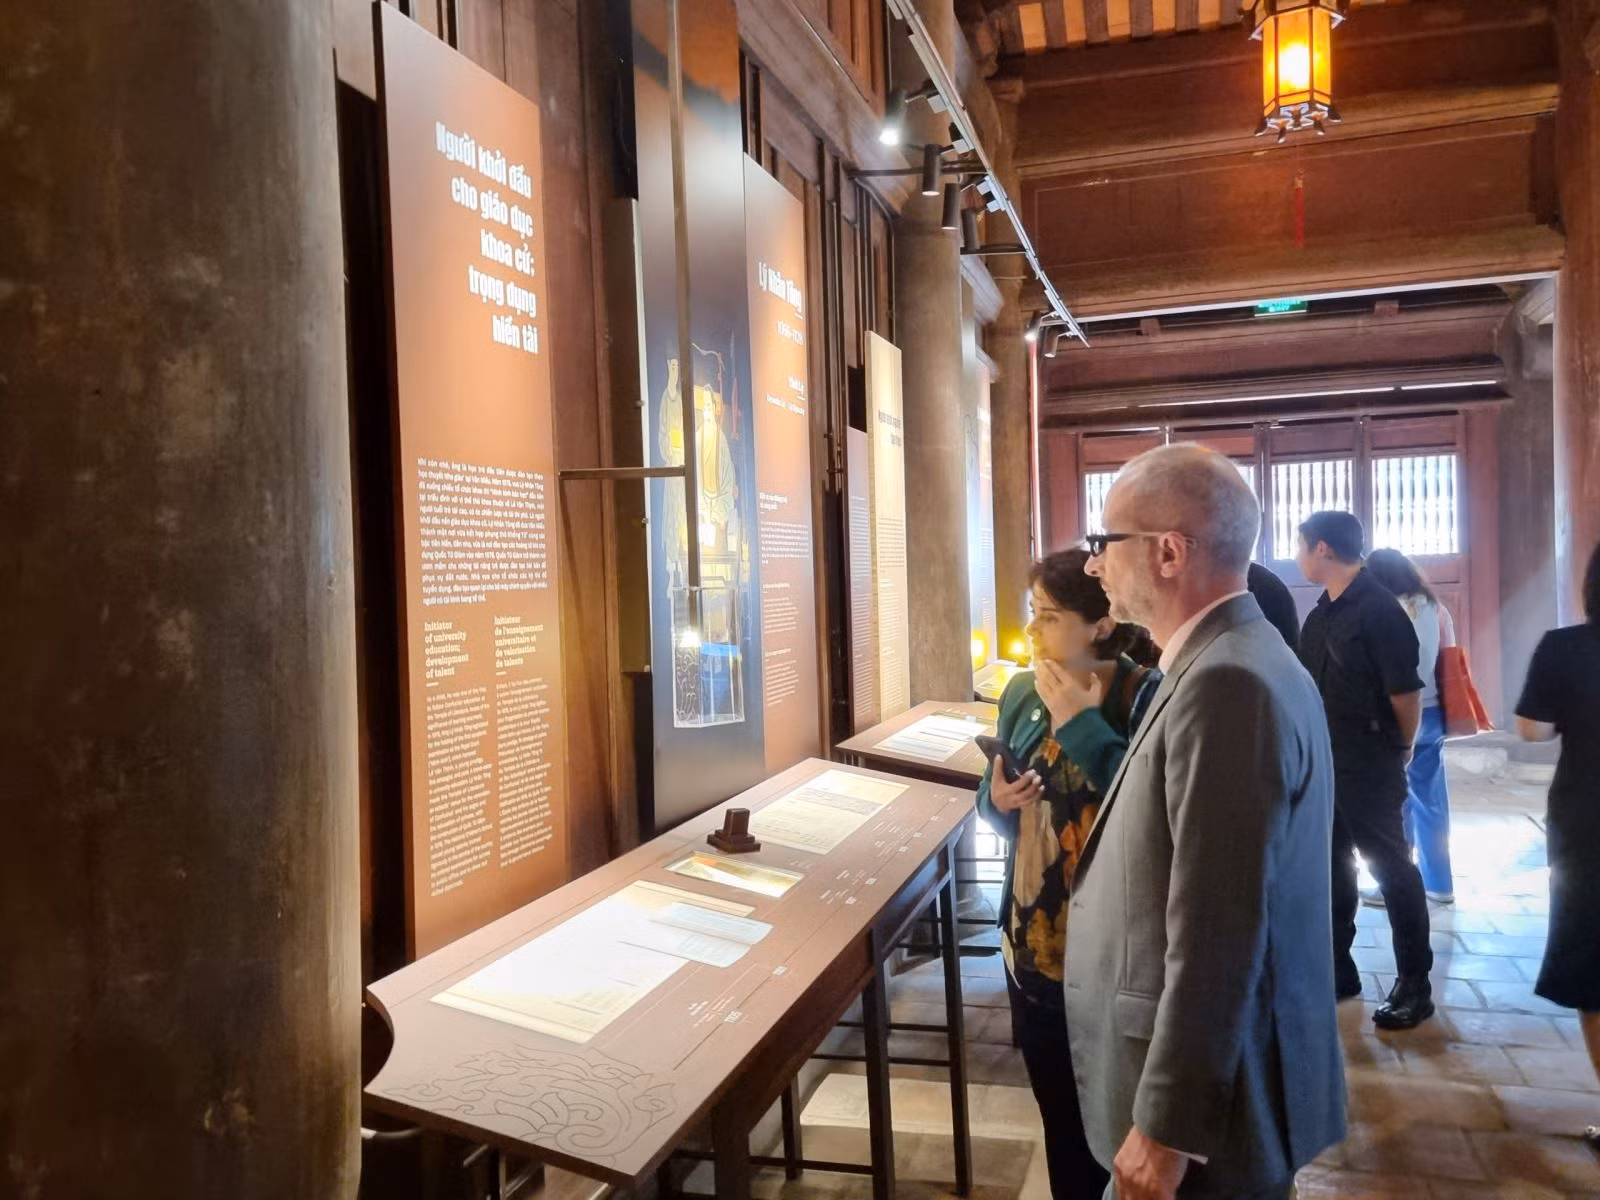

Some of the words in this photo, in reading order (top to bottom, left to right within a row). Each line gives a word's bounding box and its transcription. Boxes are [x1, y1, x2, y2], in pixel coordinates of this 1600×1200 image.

[436, 121, 476, 169] Người
[478, 145, 506, 185] khởi
[509, 164, 532, 199] đầu
[451, 177, 478, 210] cho
[480, 190, 509, 225] giáo
[511, 204, 533, 239] dục
[480, 229, 513, 267] khoa
[468, 265, 504, 306] trọng
[506, 281, 536, 317] dụng
[758, 261, 768, 291] Lý
[492, 314, 521, 349] hiền
[523, 324, 538, 354] tài
[424, 621, 453, 632] Initiator
[425, 633, 433, 644] of
[433, 631, 467, 642] university
[494, 626, 502, 636] de
[425, 654, 469, 667] development
[426, 668, 434, 679] of
[435, 666, 455, 678] talent
